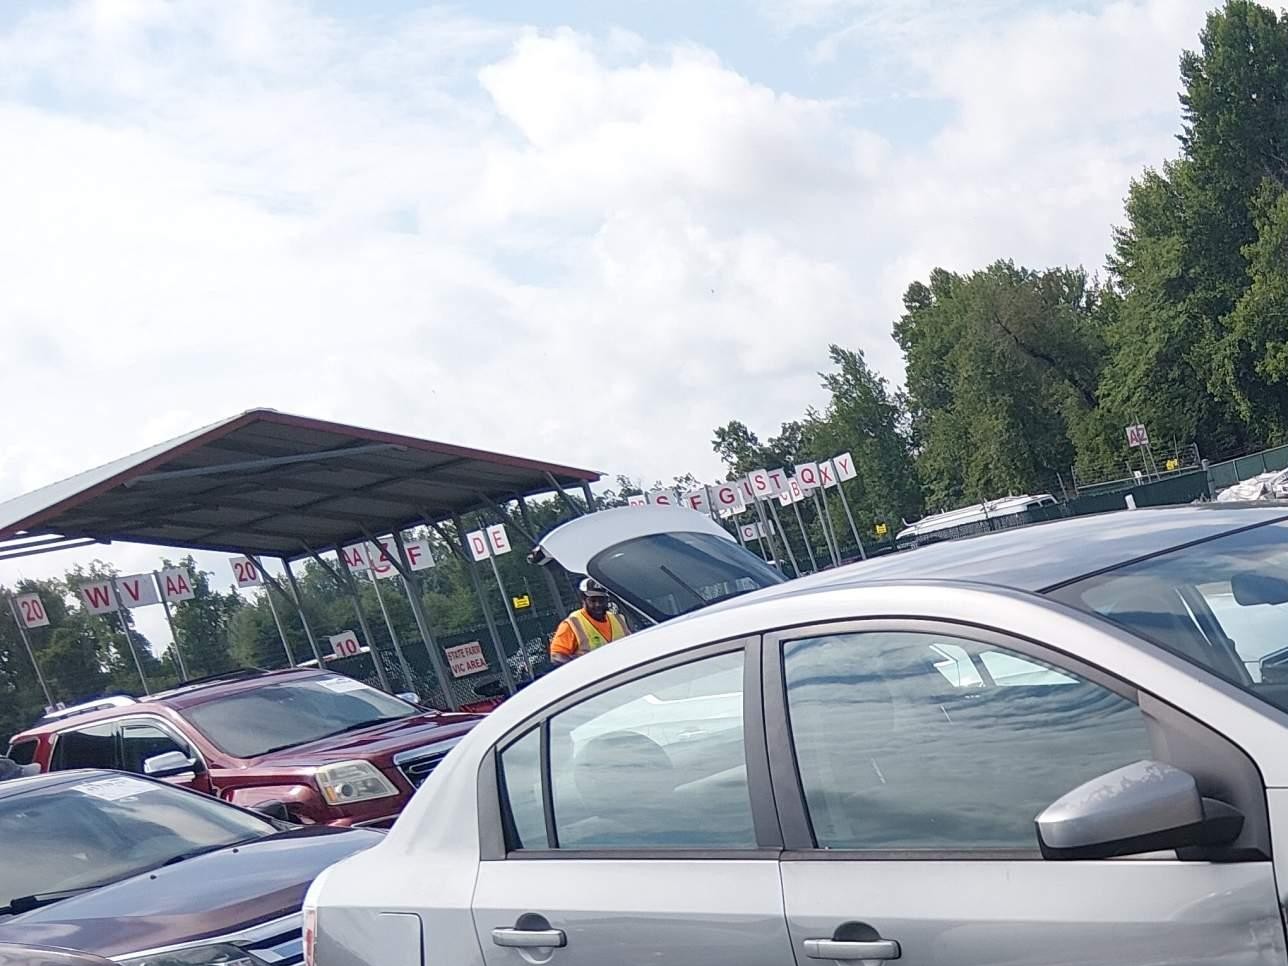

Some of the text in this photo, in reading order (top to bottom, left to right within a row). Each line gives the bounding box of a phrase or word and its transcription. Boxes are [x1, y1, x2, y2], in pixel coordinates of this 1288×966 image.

[820, 466, 833, 485] X
[838, 458, 849, 475] Y
[754, 475, 767, 490] S
[768, 474, 781, 489] T
[800, 468, 817, 485] Q
[719, 487, 735, 504] G
[791, 481, 800, 497] B
[492, 530, 505, 549] E
[744, 527, 754, 538] C
[472, 537, 485, 554] D
[342, 548, 364, 567] AA
[407, 545, 421, 566] F
[233, 562, 258, 583] 20
[122, 580, 140, 602] V
[165, 574, 191, 595] AA
[84, 585, 110, 609] W
[20, 598, 44, 622] 20
[336, 639, 357, 656] 10
